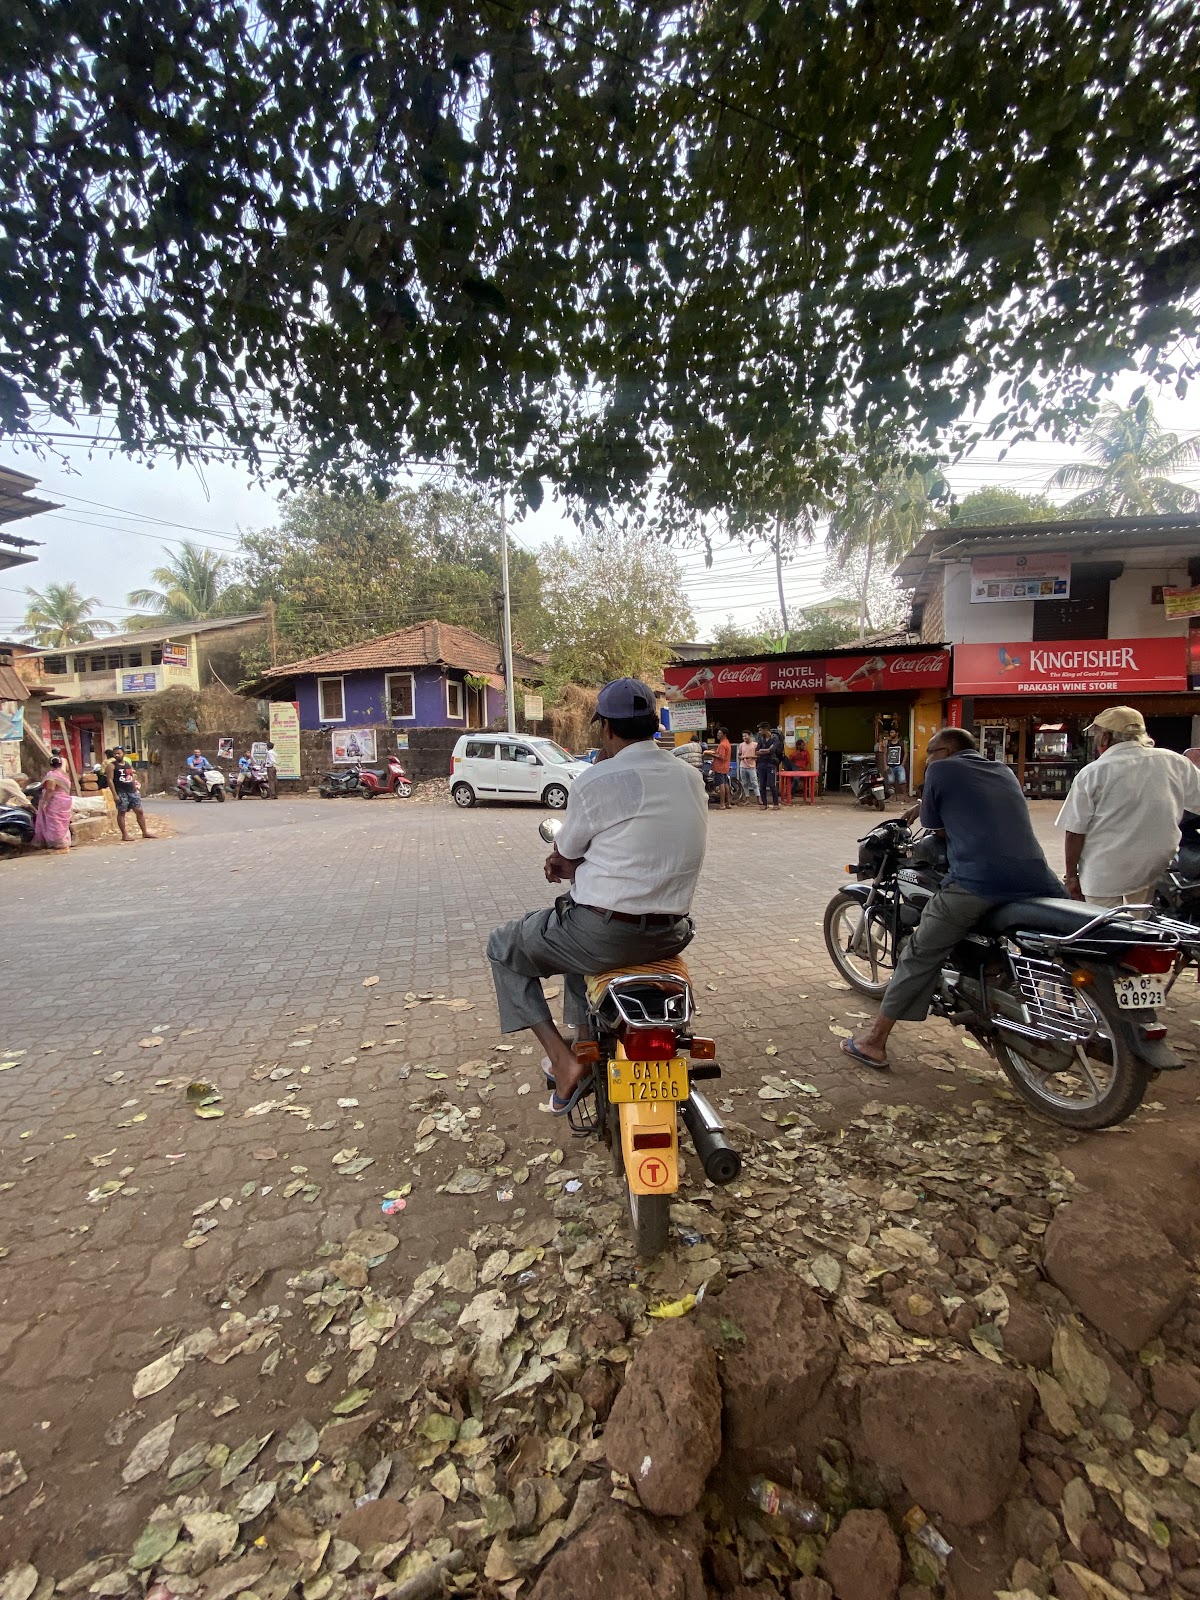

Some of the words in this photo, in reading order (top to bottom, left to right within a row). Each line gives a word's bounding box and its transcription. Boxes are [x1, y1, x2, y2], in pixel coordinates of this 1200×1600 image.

[889, 655, 946, 674] Coca-Cola
[1029, 647, 1140, 674] KINGFISHER
[717, 666, 765, 684] Coca-Cola
[778, 666, 815, 678] HOTEL
[770, 678, 823, 690] PRAKASH
[1017, 683, 1060, 692] PRAKASH
[1062, 682, 1087, 691] WINE
[1089, 682, 1118, 690] STORE
[1120, 980, 1135, 991] GA
[1120, 993, 1129, 1006] Q
[632, 1061, 672, 1080] GA11
[629, 1080, 679, 1100] T2566
[647, 1164, 660, 1183] T
